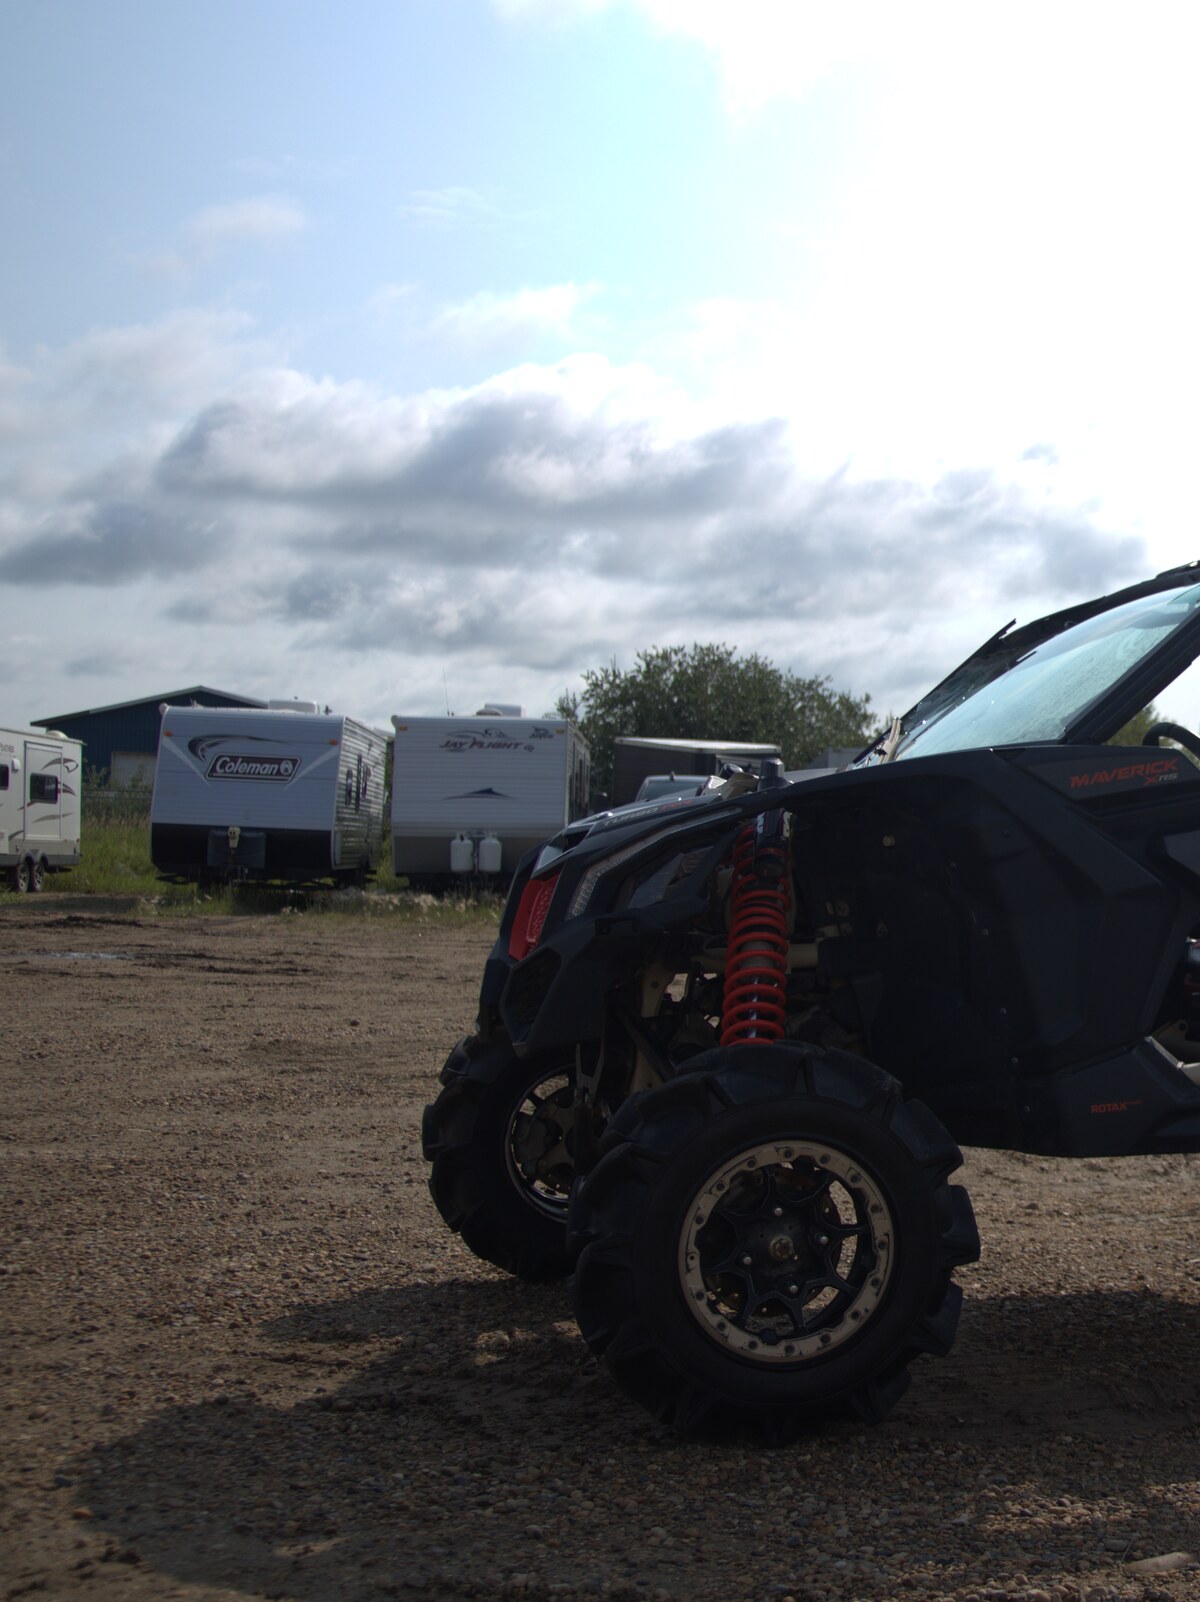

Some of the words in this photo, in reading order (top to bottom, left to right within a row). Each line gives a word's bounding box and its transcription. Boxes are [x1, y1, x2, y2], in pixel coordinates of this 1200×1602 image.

[440, 739, 467, 749] JAY
[468, 737, 523, 750] FLIGHT
[215, 757, 279, 776] Coleman
[1070, 757, 1180, 789] MAVERICK
[1090, 1102, 1127, 1114] ROTAX
